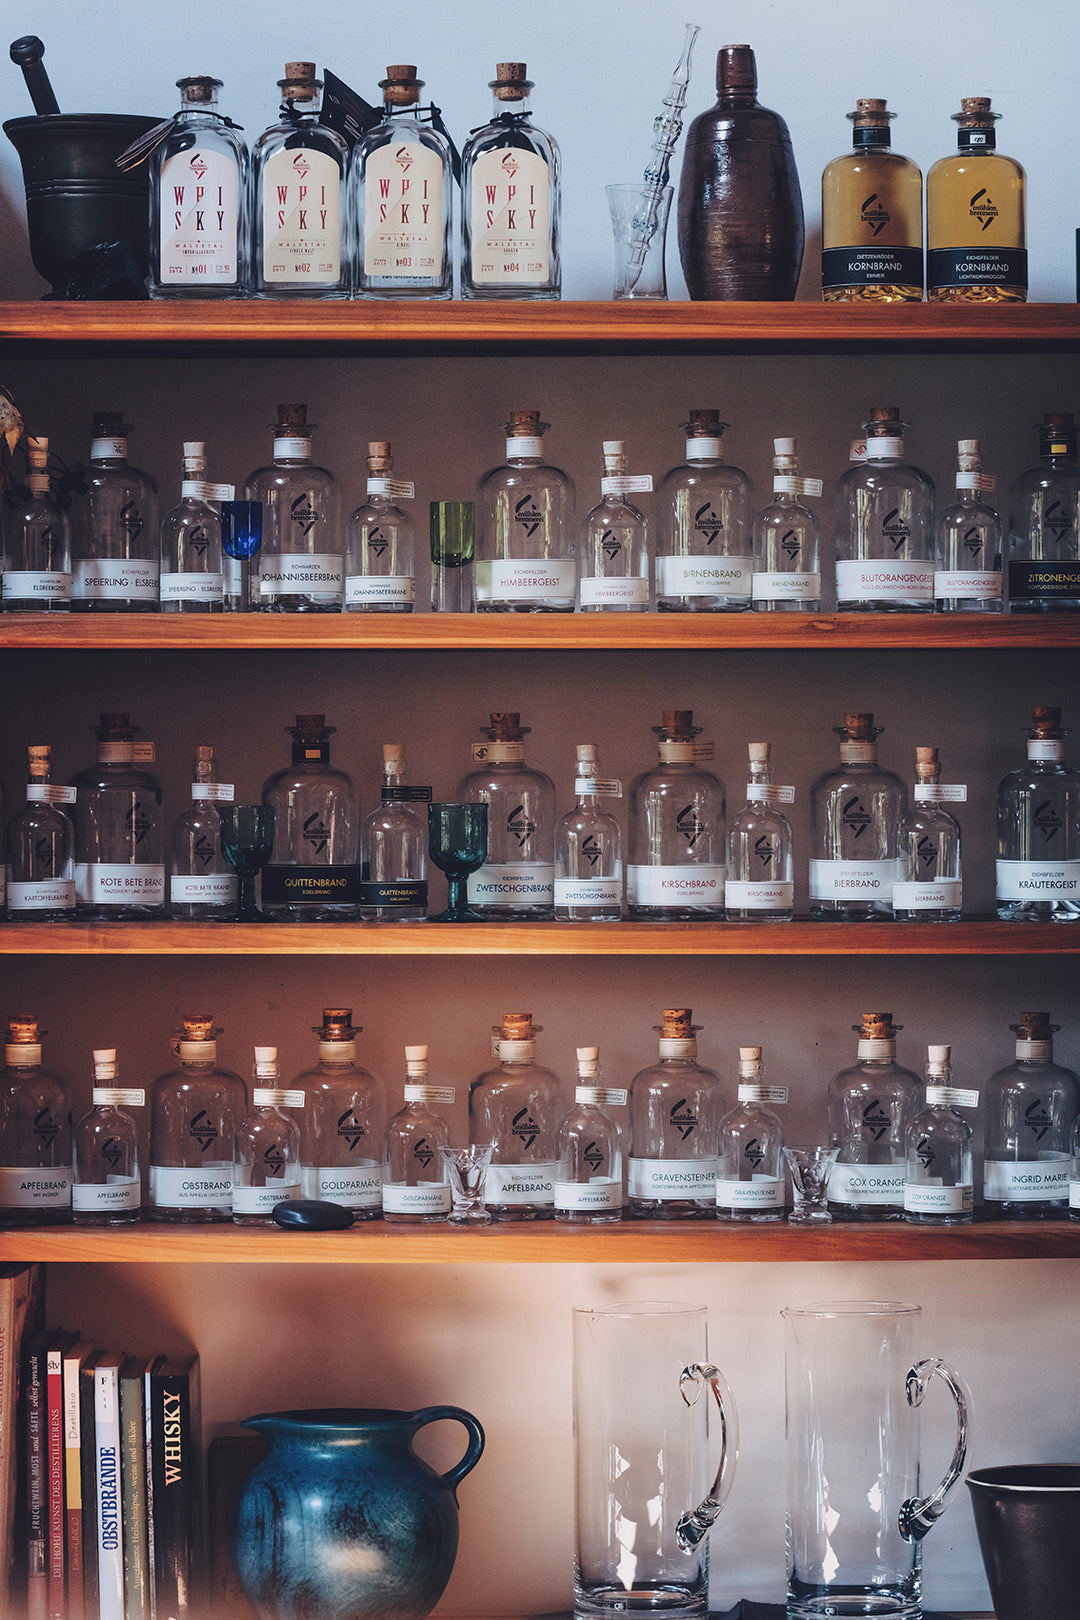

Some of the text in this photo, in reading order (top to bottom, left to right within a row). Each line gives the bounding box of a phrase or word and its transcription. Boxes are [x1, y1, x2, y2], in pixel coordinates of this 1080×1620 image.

[848, 262, 902, 271] KORNBRAND
[261, 573, 340, 582] JOHANNISBEERBRAND
[684, 570, 742, 578] BIRNENBRAND
[85, 578, 128, 586] SPEIERLING
[501, 578, 560, 586] HIMBEERGEIST
[100, 878, 122, 886] ROTE
[125, 878, 142, 886] BETE
[285, 879, 347, 887] QUITTENBRAND
[662, 880, 717, 888] KIRSCHBRAND
[834, 880, 880, 888] BIERBRAND
[1019, 879, 1077, 888] KRÄUTERGEIST
[476, 884, 552, 893] ZWETSCHGENBRAND
[652, 1173, 716, 1182] GRAVENSTEINER
[1044, 1173, 1068, 1181] MARIE
[20, 1181, 67, 1190] APFELBRAND
[182, 1181, 232, 1190] OBSTBRAND
[321, 1179, 380, 1189] GOLDPARMÄNE
[849, 1178, 905, 1187] COX ORANGE
[501, 1183, 552, 1192] APFELBRAND
[29, 1356, 40, 1386] gemacht
[30, 1387, 39, 1407] selbst
[68, 1392, 78, 1439] Destillatio
[30, 1411, 38, 1433] SÄFTE
[163, 1390, 182, 1486] WHISKY
[51, 1408, 60, 1478] DESTILLIERENS
[31, 1455, 40, 1476] MOST
[32, 1477, 41, 1529] FRUCHTWEIN,
[100, 1447, 118, 1550] OBSTBRÄNDE
[52, 1500, 61, 1532] KUNST
[53, 1534, 61, 1564] HOHE
